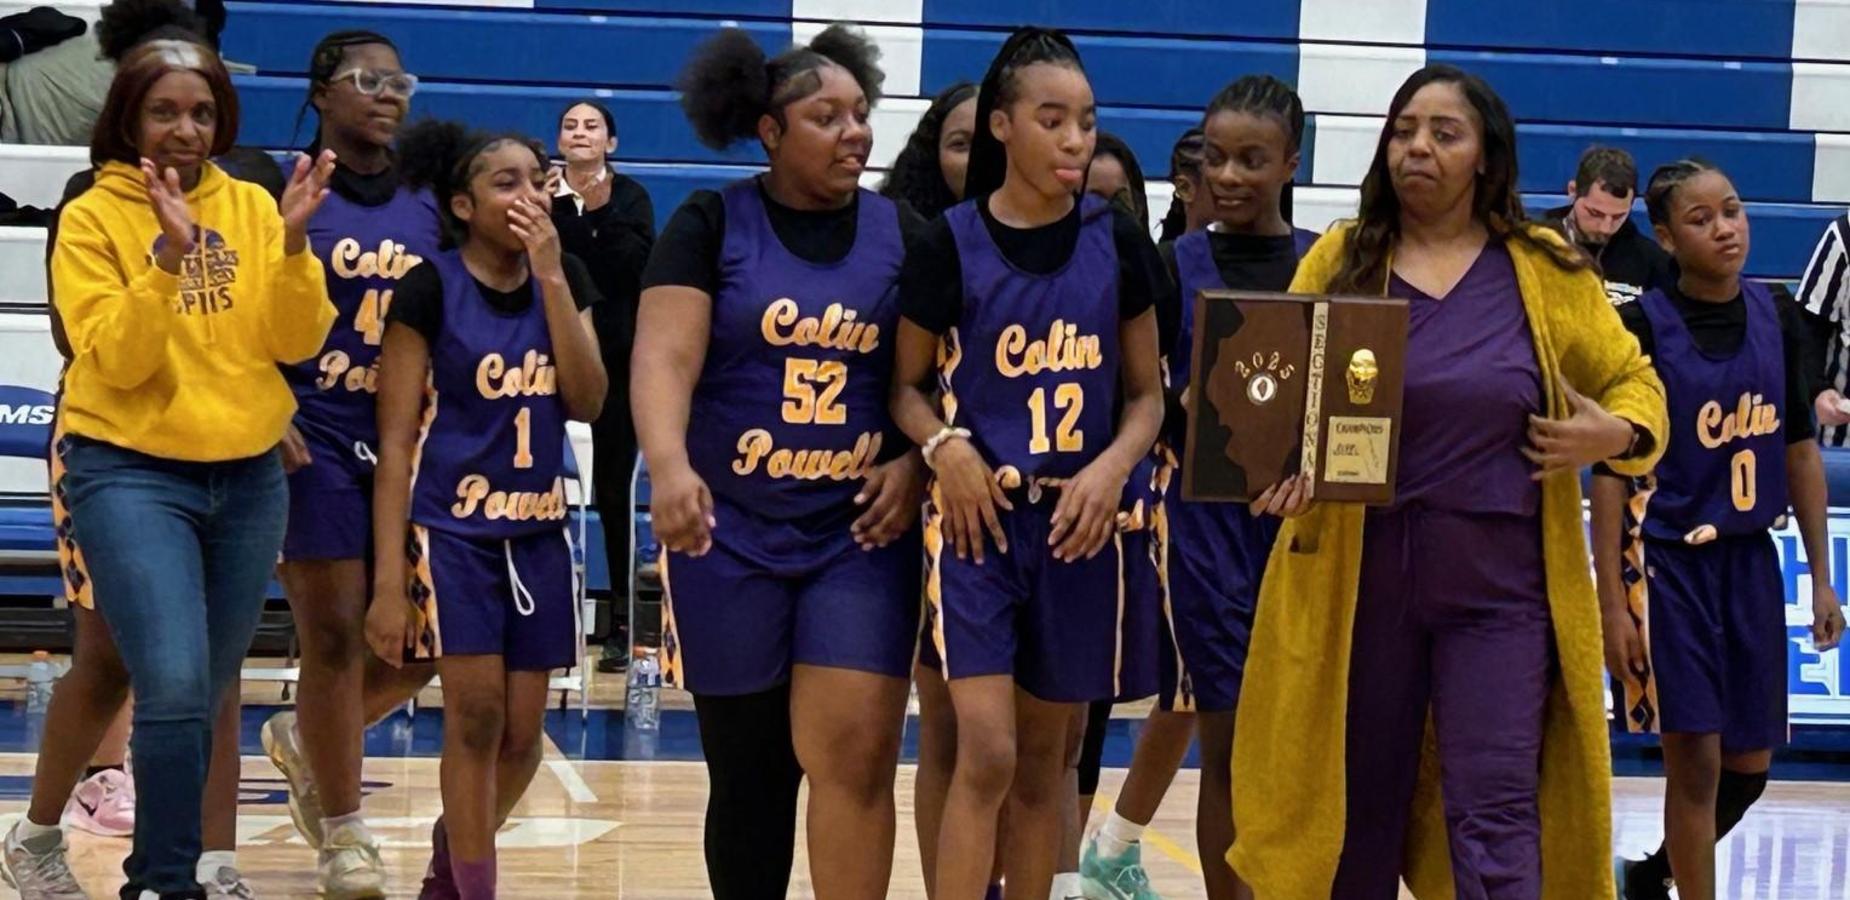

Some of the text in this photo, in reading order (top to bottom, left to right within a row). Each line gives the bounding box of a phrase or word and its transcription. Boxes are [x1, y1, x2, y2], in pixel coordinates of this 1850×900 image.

[761, 297, 880, 353] Colin
[995, 318, 1103, 378] Colin
[781, 357, 848, 425] 52
[1234, 351, 1295, 380] 2025
[513, 406, 534, 469] 1
[1027, 382, 1084, 455] 12
[1696, 391, 1780, 449] Colin
[731, 428, 883, 481] Powell
[1731, 448, 1757, 512] 0
